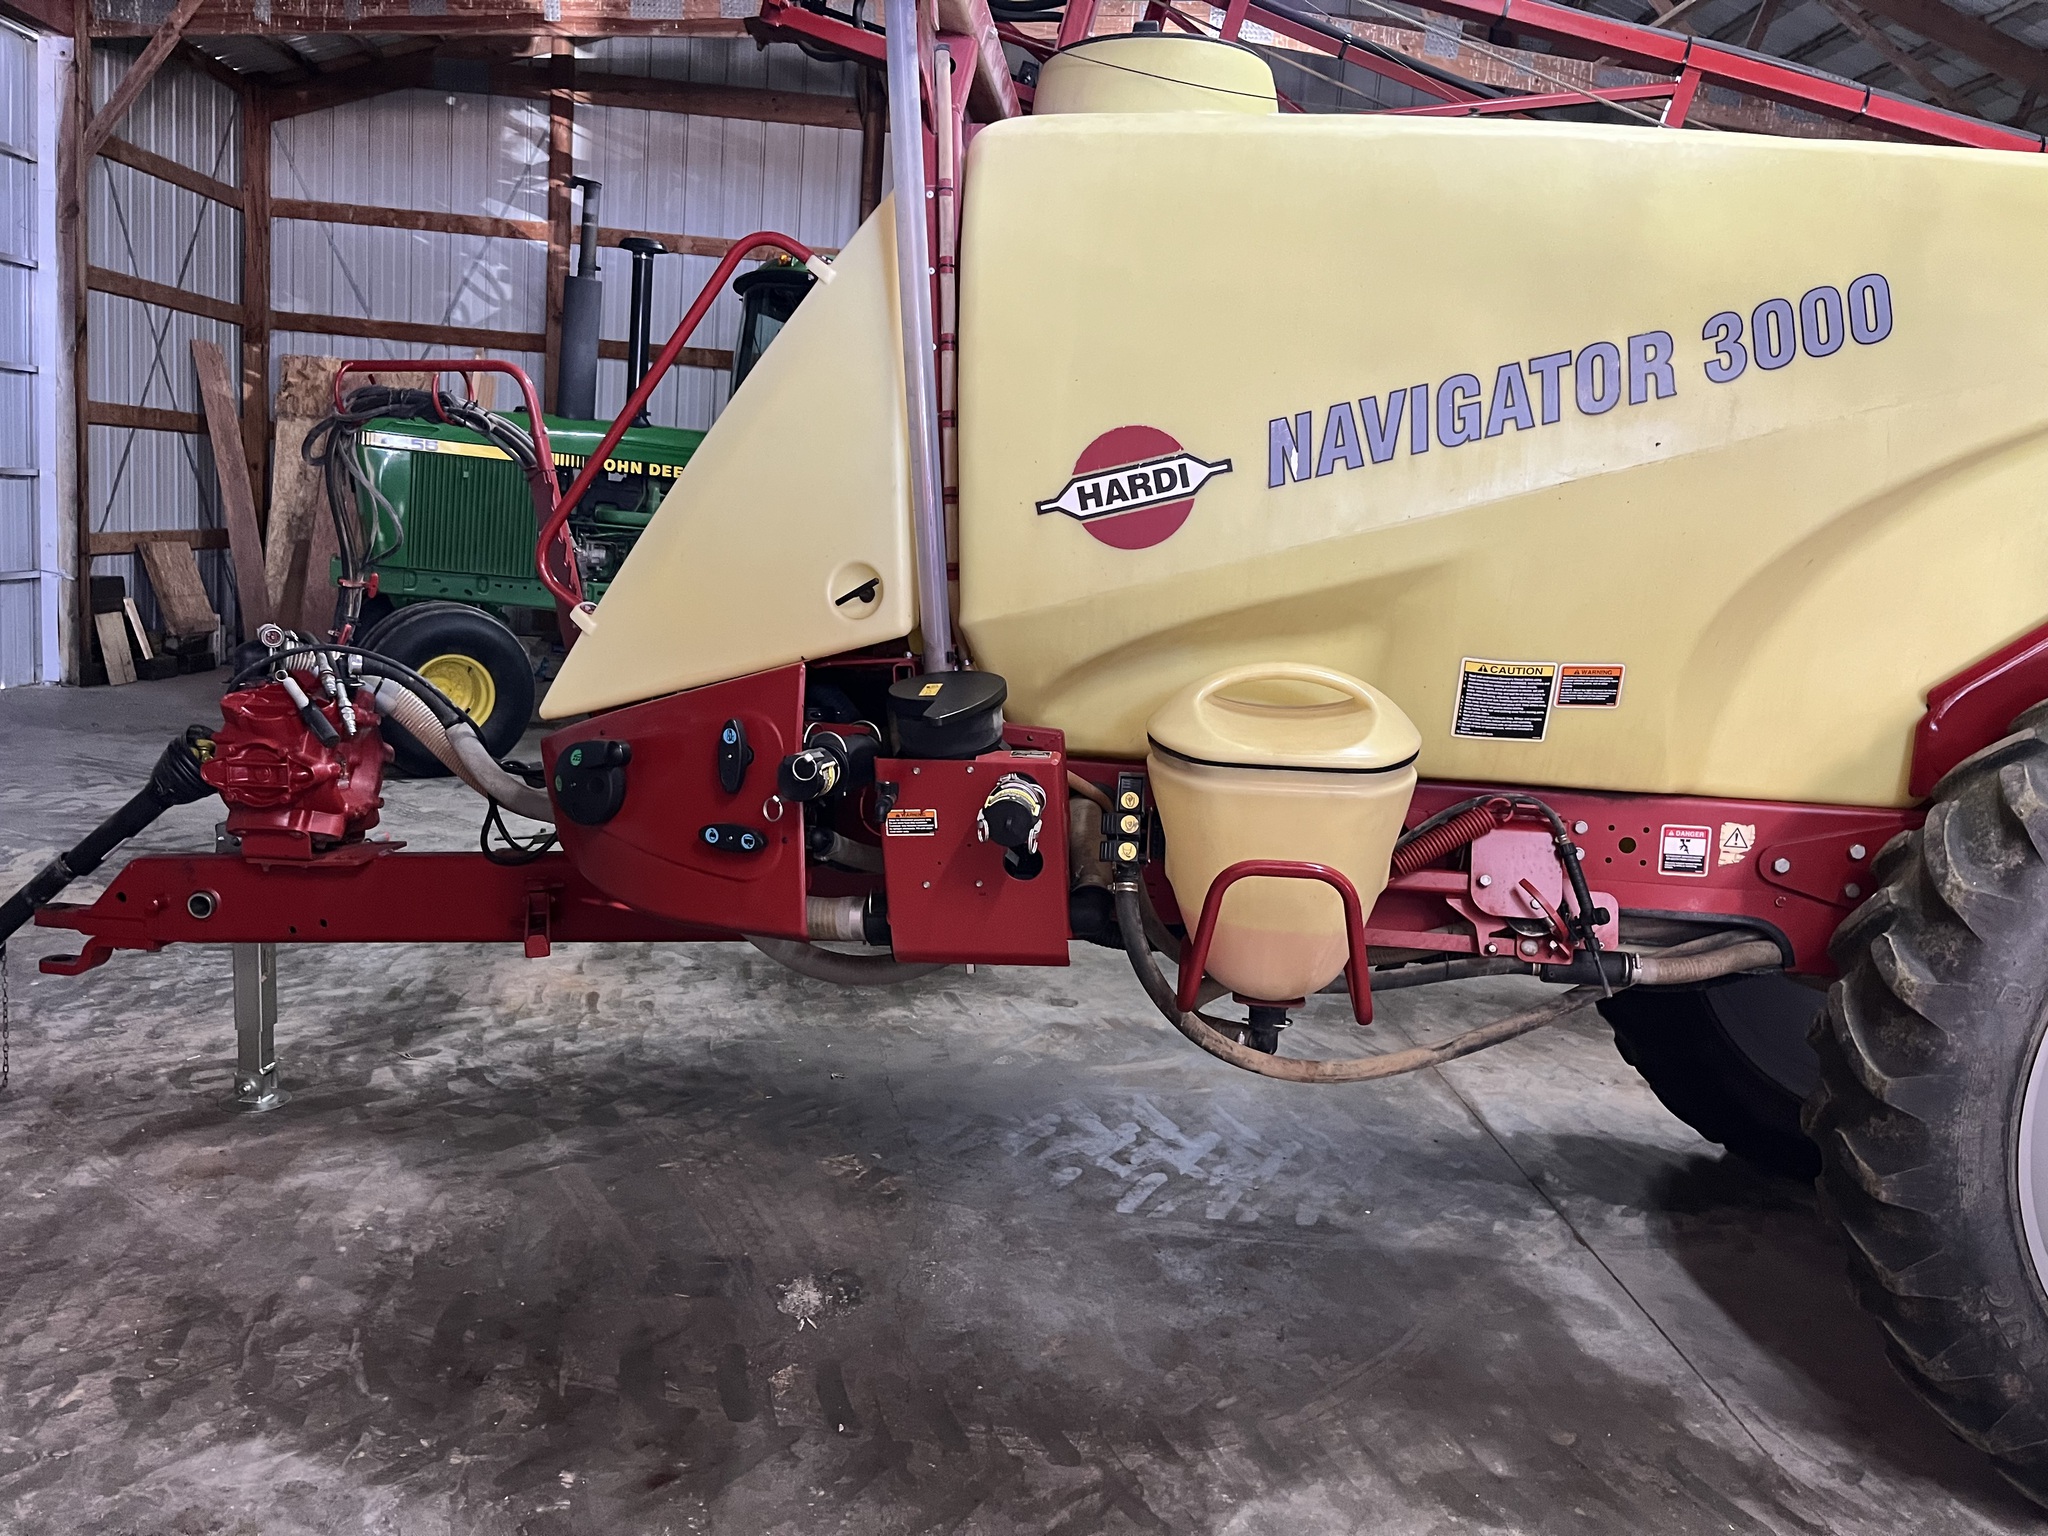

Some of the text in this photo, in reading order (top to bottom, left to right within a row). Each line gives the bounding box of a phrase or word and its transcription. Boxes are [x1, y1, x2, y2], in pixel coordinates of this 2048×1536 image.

[1268, 273, 1893, 488] NAVIGATOR 3000
[603, 459, 684, 478] OHN DEE
[1077, 463, 1190, 511] HARDI
[1490, 665, 1544, 675] CAUTION
